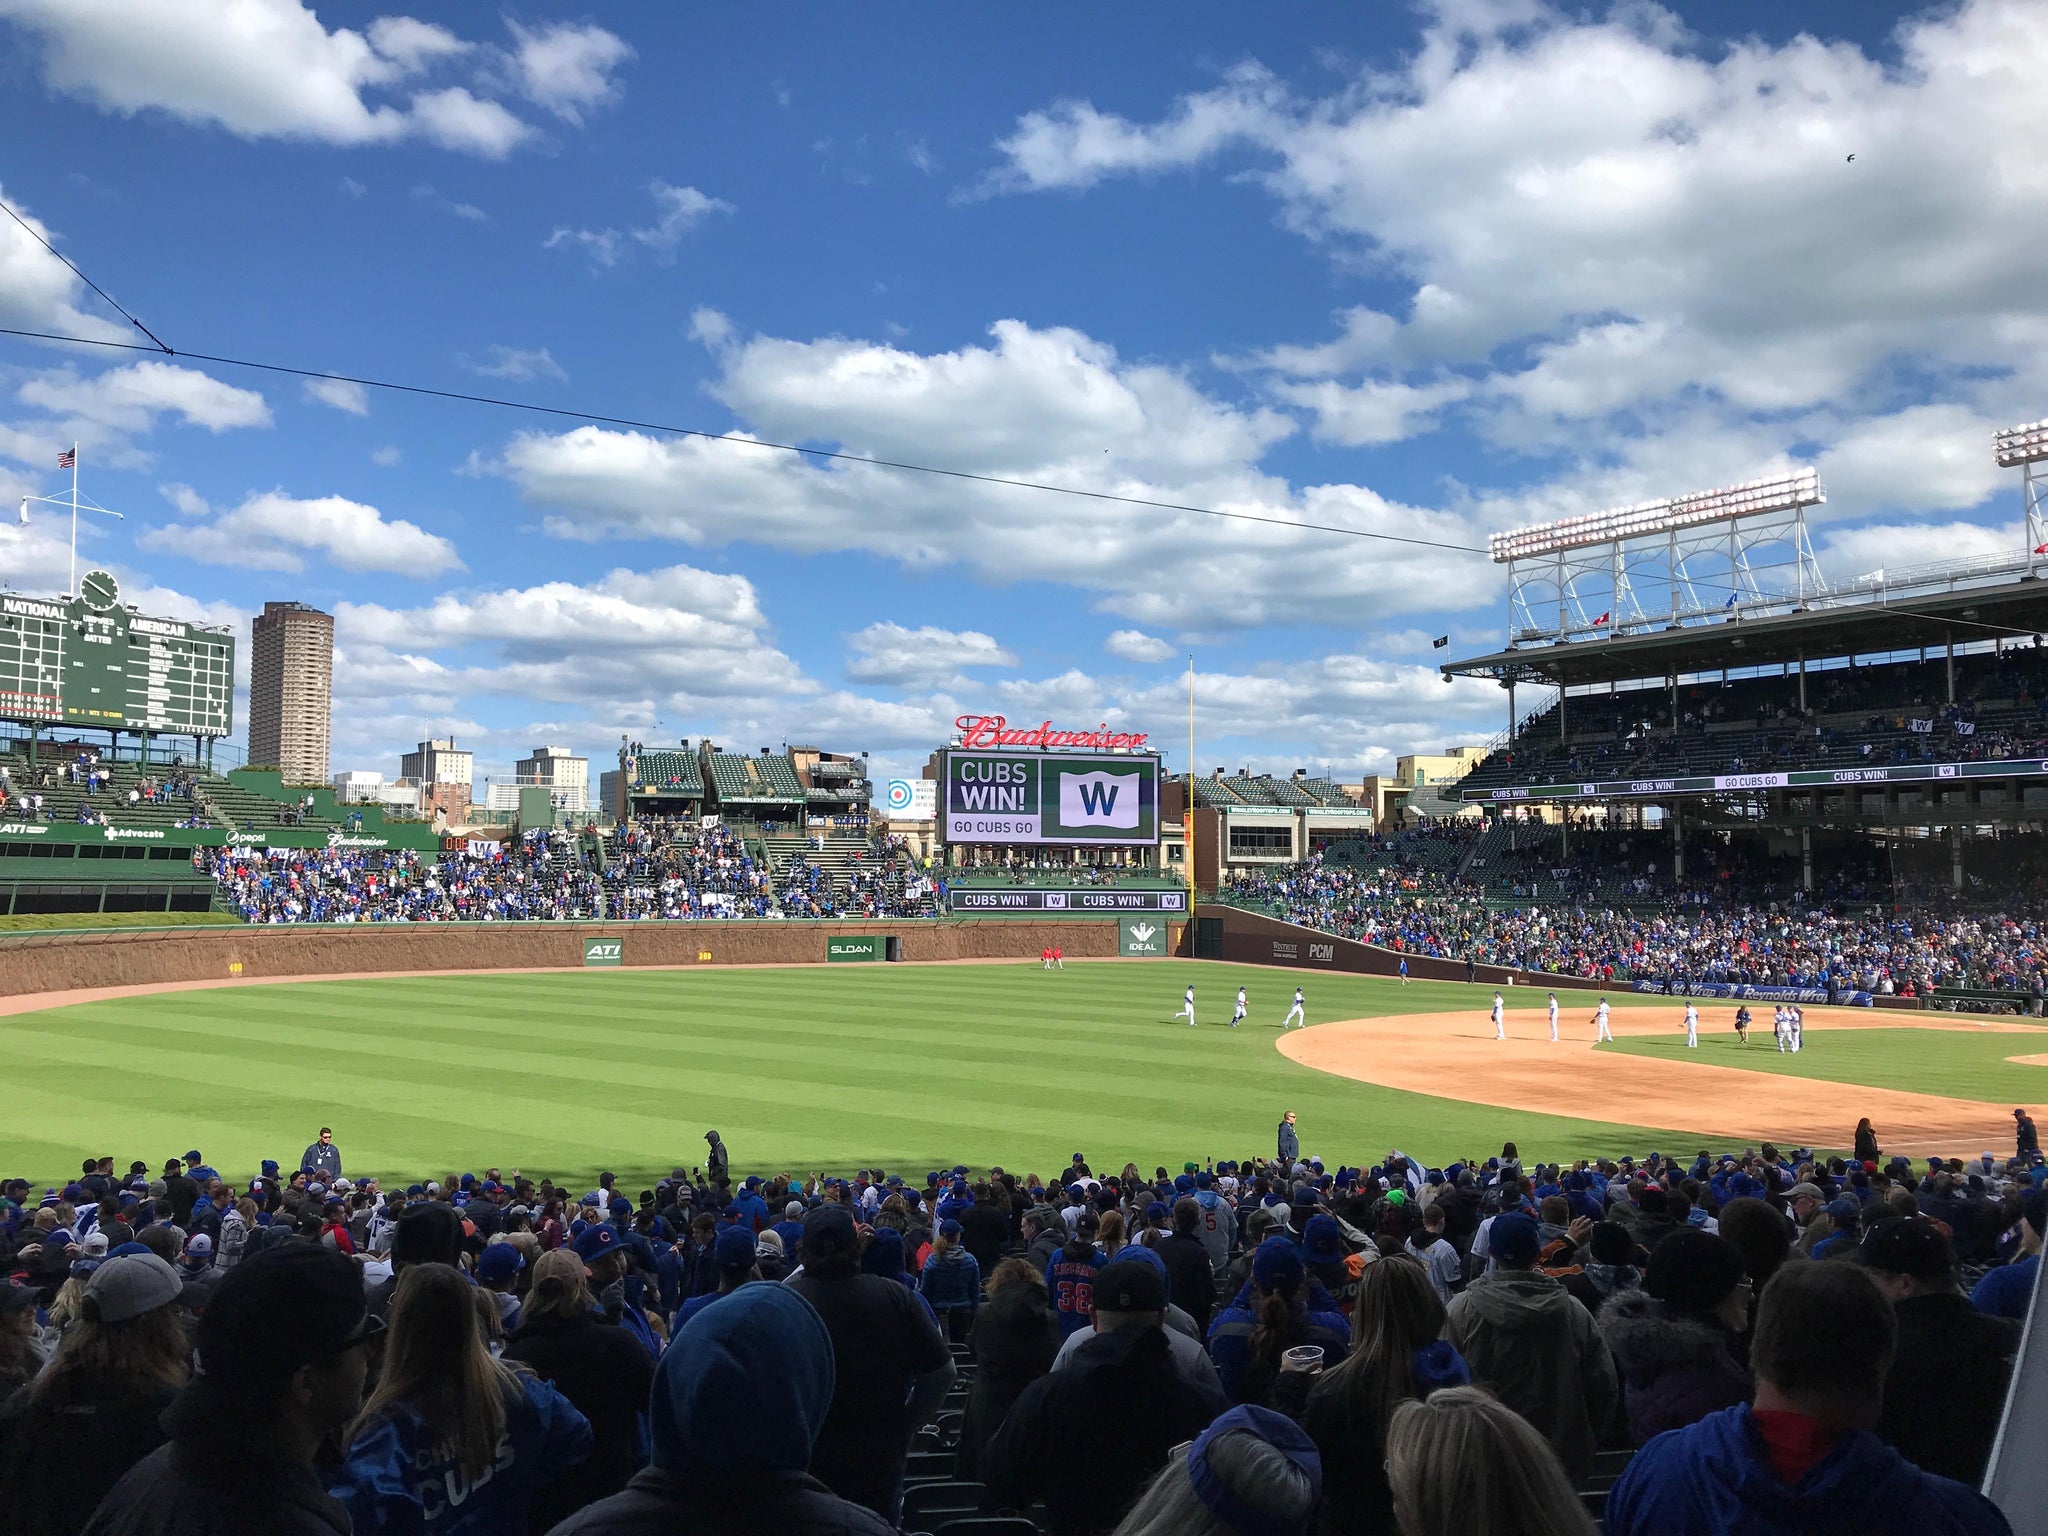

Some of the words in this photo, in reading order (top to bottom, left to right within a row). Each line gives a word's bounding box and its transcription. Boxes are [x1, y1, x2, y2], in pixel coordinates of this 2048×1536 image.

[4, 599, 67, 620] NATIONAL
[129, 618, 186, 637] AMERICAN
[1916, 720, 1928, 730] W
[1956, 723, 1971, 733] W
[955, 715, 1148, 748] Budweiser
[960, 761, 1028, 784] CUBS
[1834, 772, 1862, 782] CUBS
[1863, 770, 1888, 780] WIN!
[1631, 782, 1653, 791] CUBS
[1655, 782, 1675, 790] WIN!
[1725, 778, 1737, 787] GO
[1740, 777, 1762, 786] CUBS
[1765, 776, 1778, 785] GO
[960, 785, 1025, 812] WIN!
[1079, 781, 1120, 817] W
[1492, 790, 1511, 798] CUBS
[1512, 790, 1529, 798] WIN!
[1308, 808, 1368, 816] WRIGLEYROOFTOPS.COM
[704, 817, 716, 826] W
[954, 820, 972, 833] GO
[976, 822, 1011, 834] CUBS
[1016, 822, 1033, 834] GO
[118, 828, 165, 838] Advocate
[240, 833, 266, 843] pepsi
[327, 833, 388, 846] Budweiser
[474, 843, 492, 857] W
[965, 895, 997, 906] CUBS
[1000, 895, 1028, 906] WIN!
[1050, 896, 1062, 906] W
[1083, 895, 1114, 906] CUBS
[1117, 895, 1144, 906] WIN!
[1164, 897, 1177, 906] W
[587, 945, 620, 956] ATI
[831, 945, 872, 954] SLOAN
[1129, 943, 1157, 951] IDEAL
[1309, 944, 1334, 959] PCM
[1687, 984, 1716, 997] Wrap
[1743, 987, 1798, 1001] Reynolds
[1205, 1213, 1217, 1232] 5
[600, 1231, 610, 1242] C
[1057, 1280, 1094, 1314] 38
